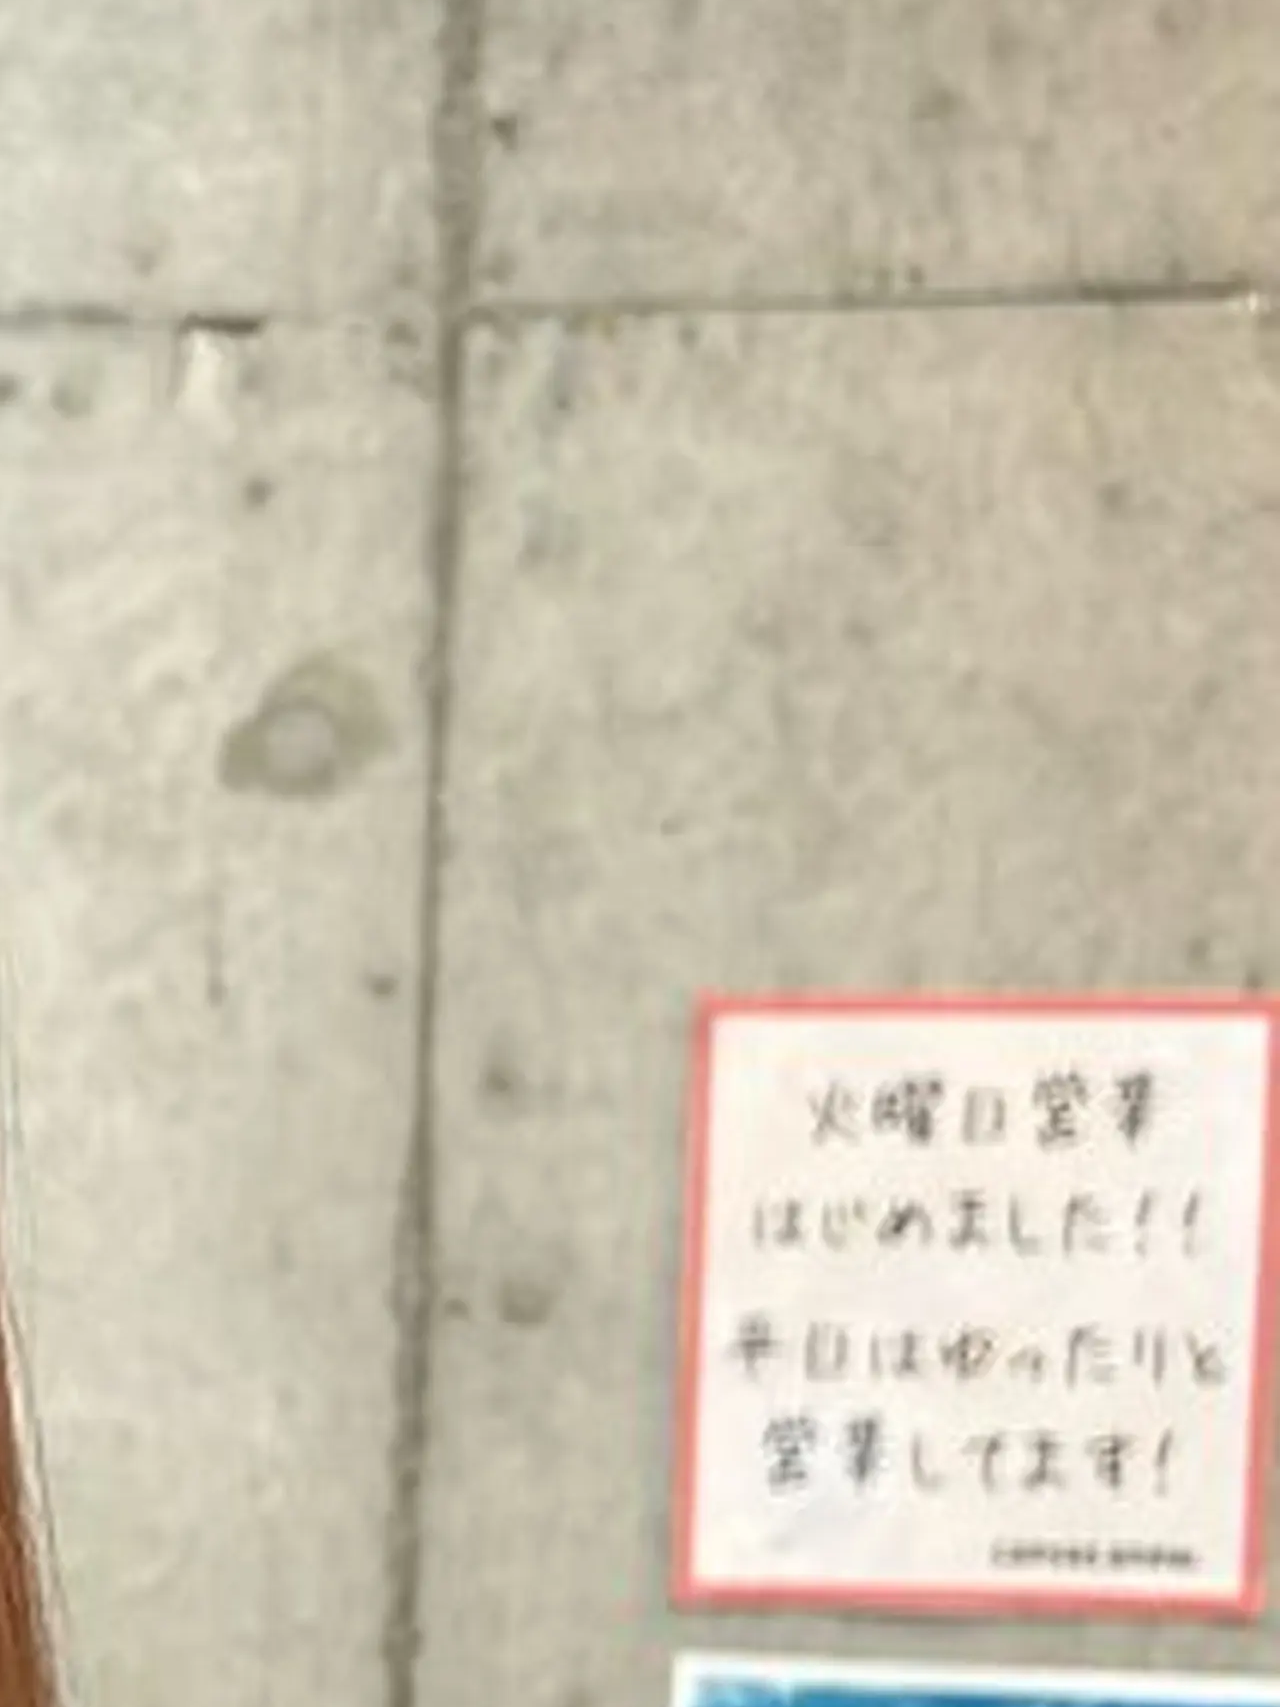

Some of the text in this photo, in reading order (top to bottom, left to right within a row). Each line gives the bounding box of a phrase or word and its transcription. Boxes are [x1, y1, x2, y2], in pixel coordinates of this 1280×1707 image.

[808, 1069, 1154, 1153] 火曜日営業
[728, 1311, 1228, 1389] 平日はゆったりと
